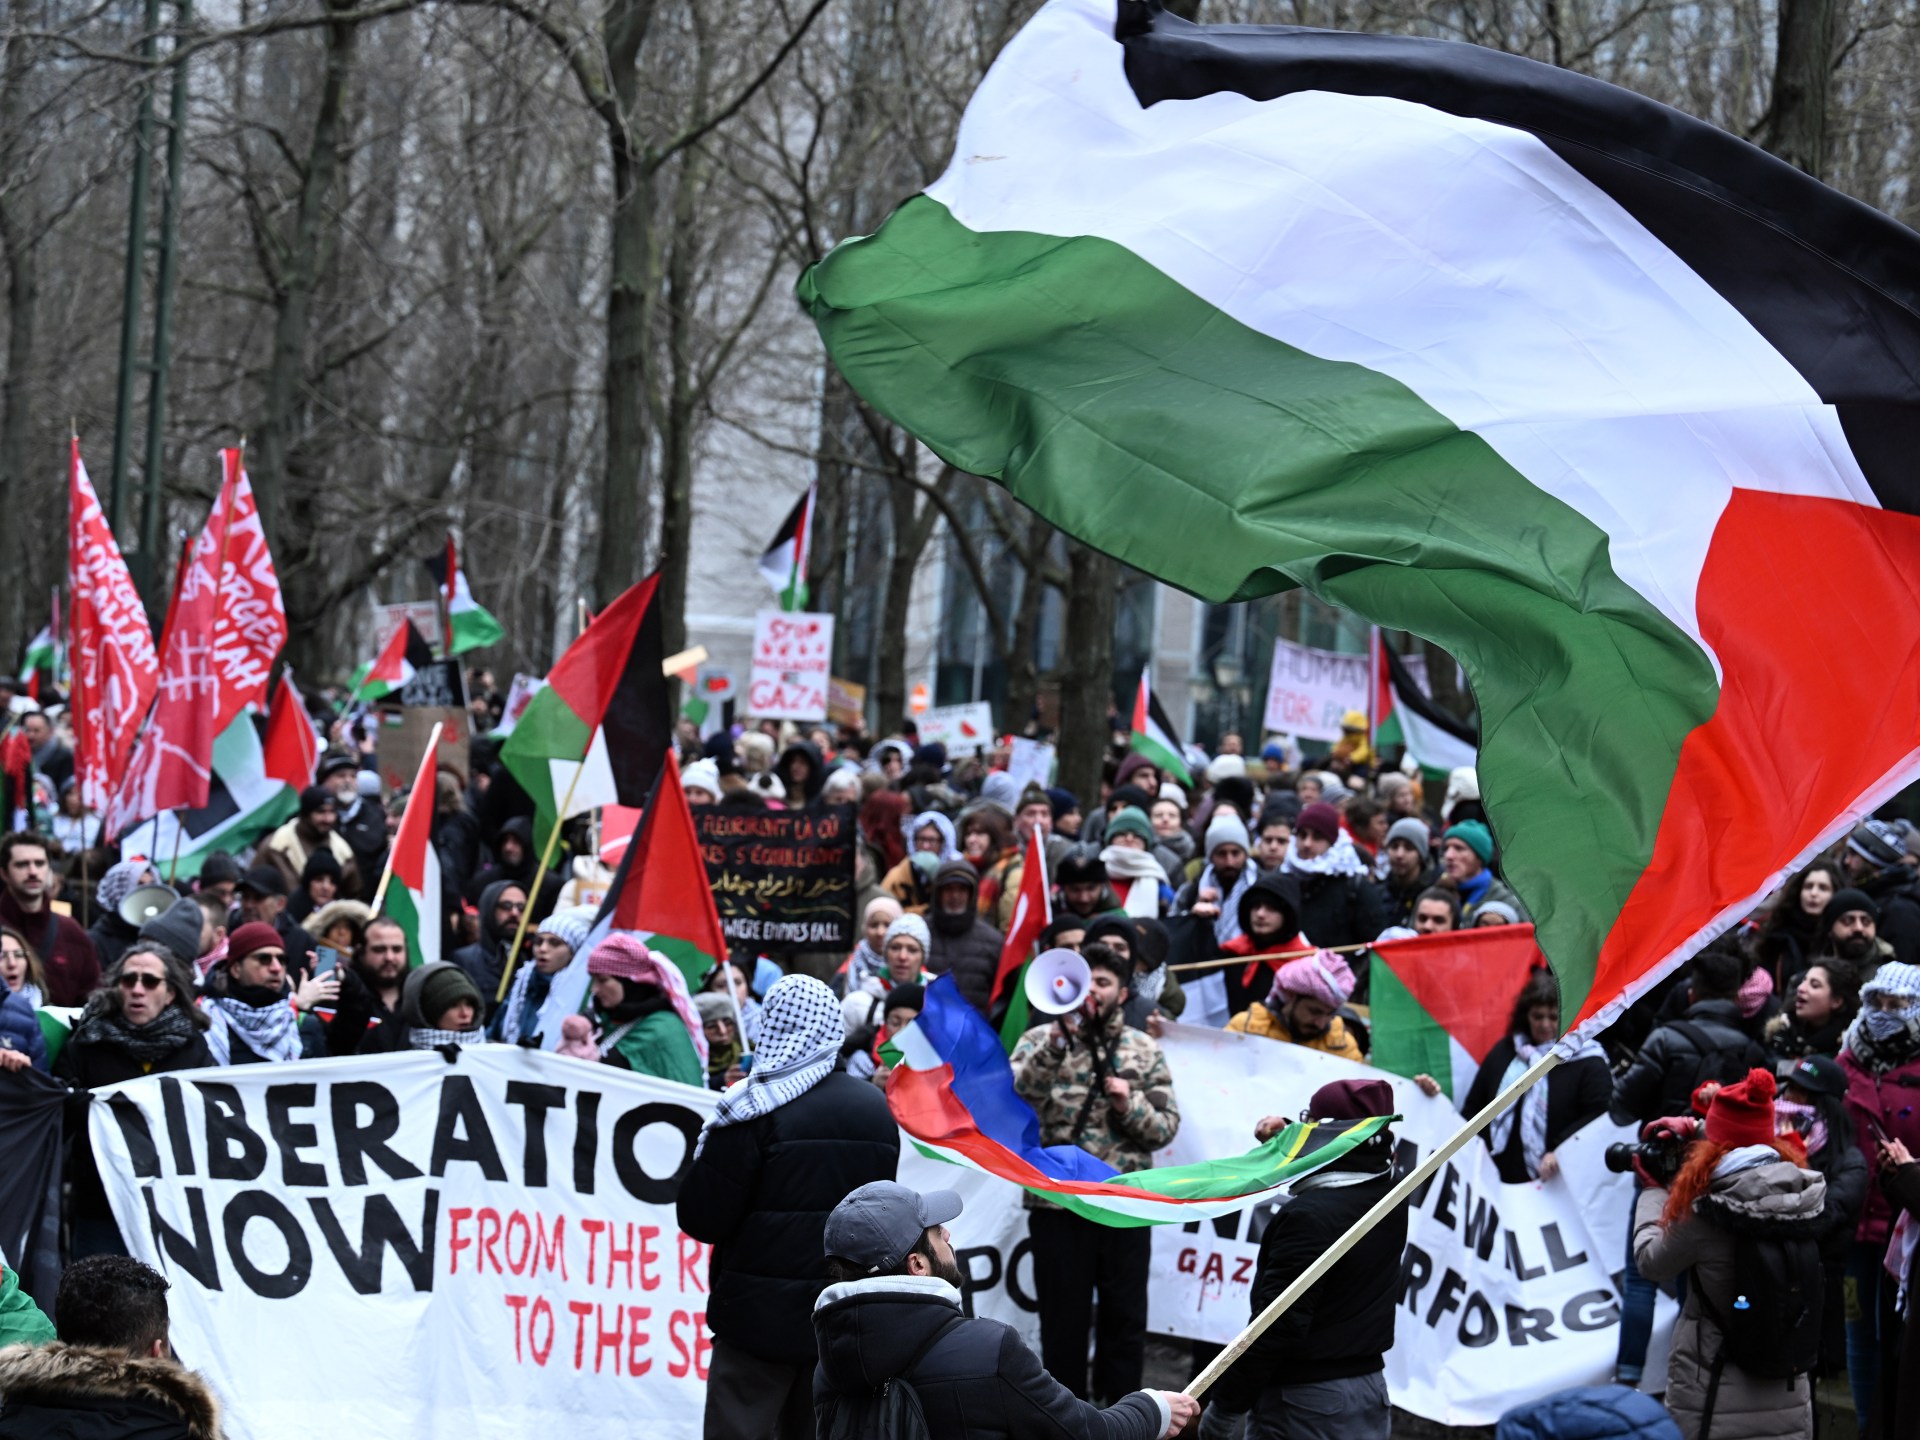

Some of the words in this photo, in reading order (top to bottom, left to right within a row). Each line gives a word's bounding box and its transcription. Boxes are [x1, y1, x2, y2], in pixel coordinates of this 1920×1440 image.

[748, 680, 827, 711] GAZA
[104, 1075, 704, 1205] LIBERATIO
[140, 1187, 440, 1300] NOW
[448, 1207, 569, 1283] FROM
[581, 1218, 661, 1292] THE
[1177, 1248, 1253, 1284] GAZ
[504, 1294, 555, 1367] TO
[568, 1300, 654, 1377] THE
[668, 1309, 713, 1381] SE
